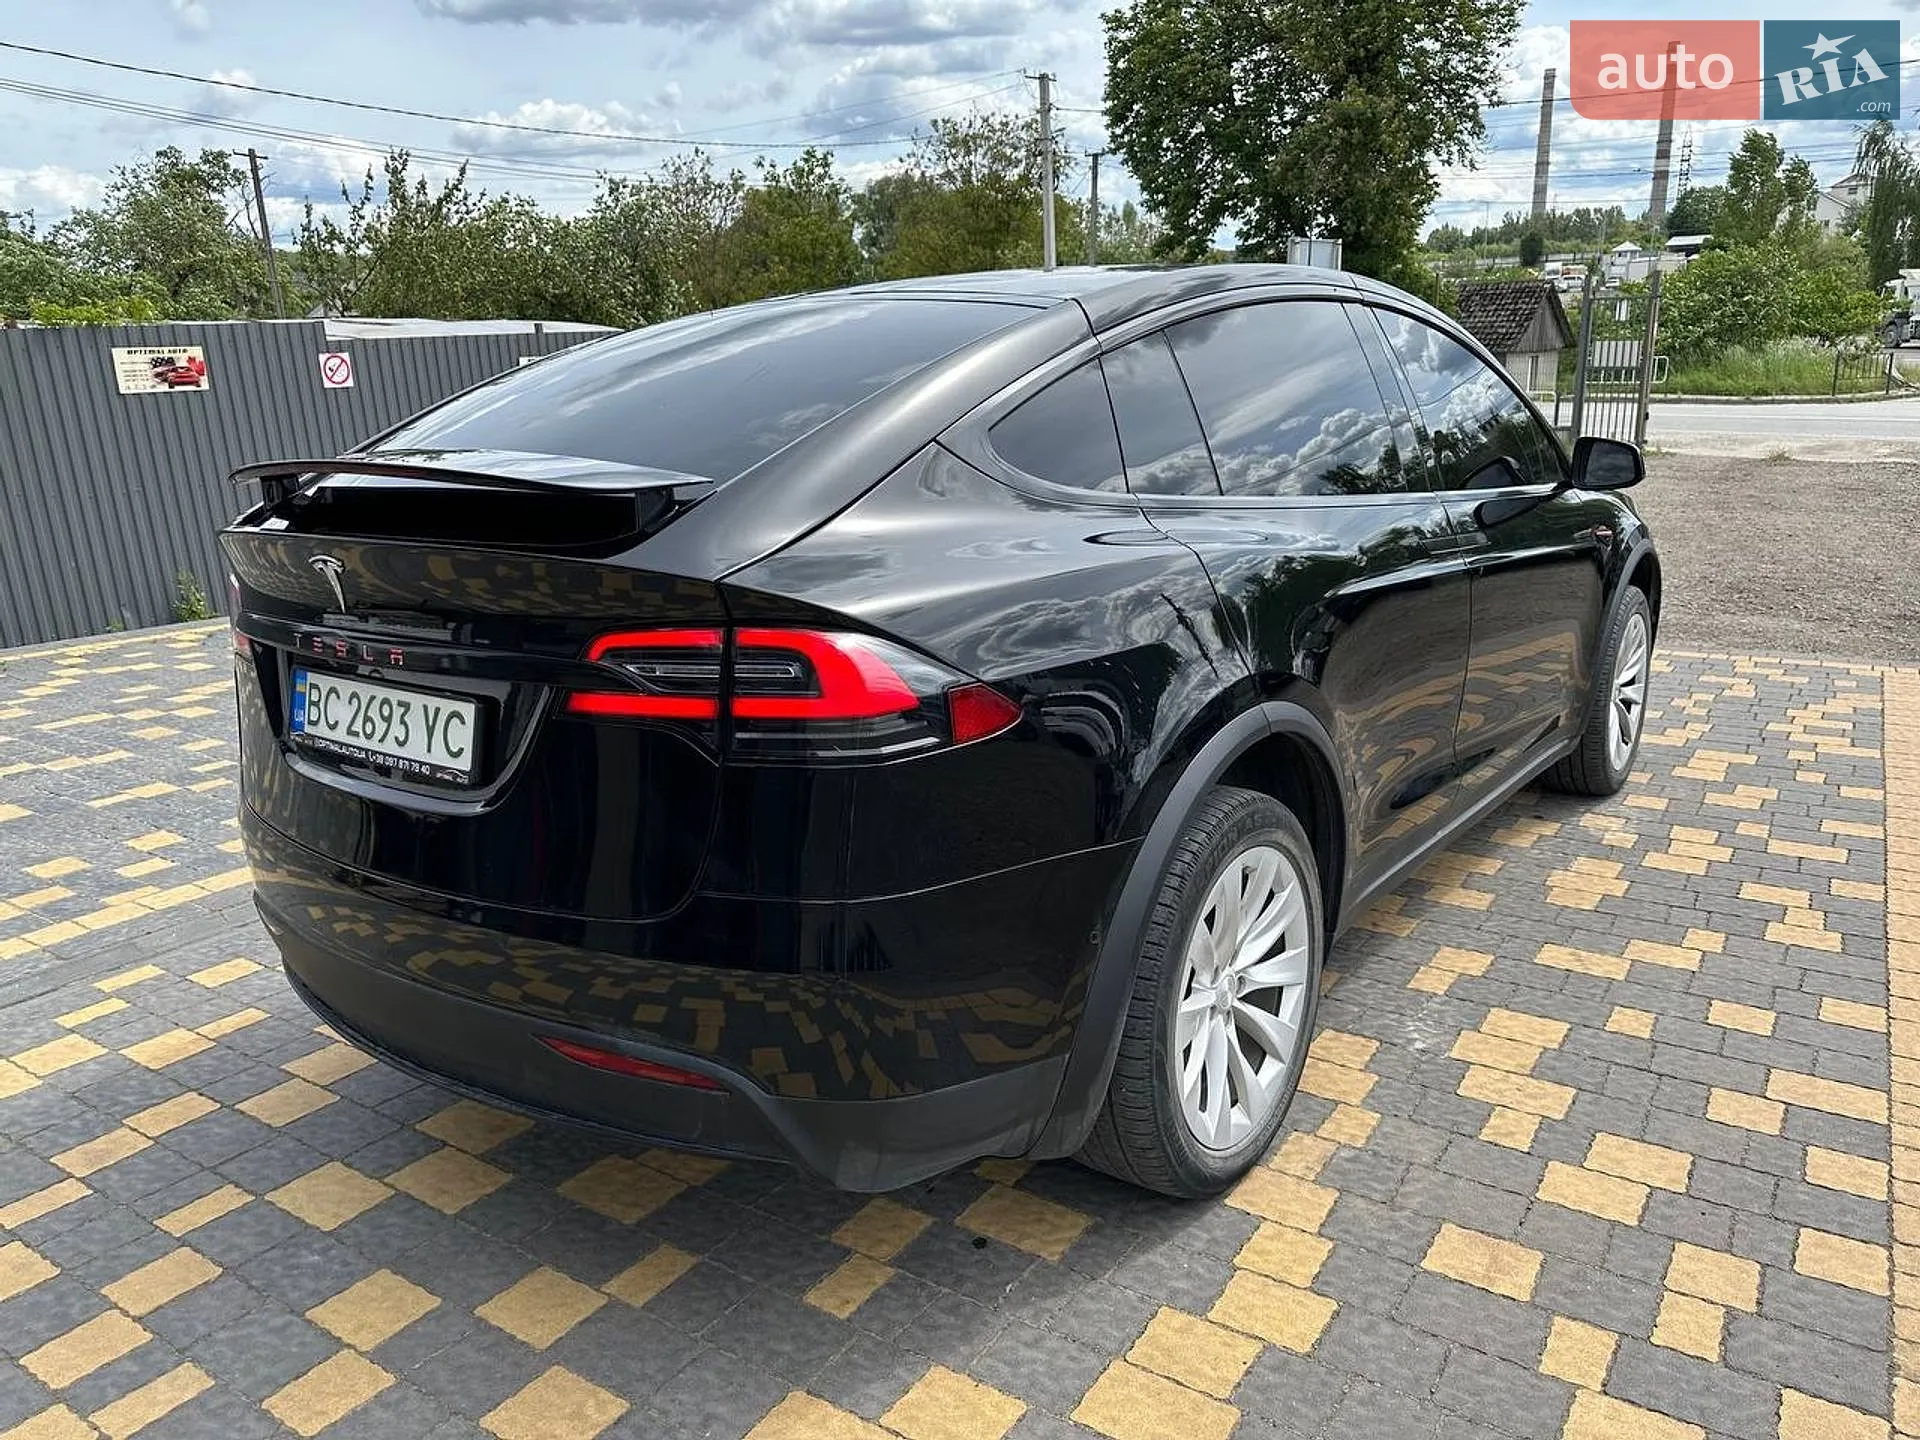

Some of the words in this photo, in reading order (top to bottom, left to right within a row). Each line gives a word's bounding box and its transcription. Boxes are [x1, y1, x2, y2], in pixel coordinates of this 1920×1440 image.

[293, 632, 405, 666] TESLA
[307, 682, 341, 731] BC
[346, 690, 411, 747] 2693
[422, 703, 467, 759] YC
